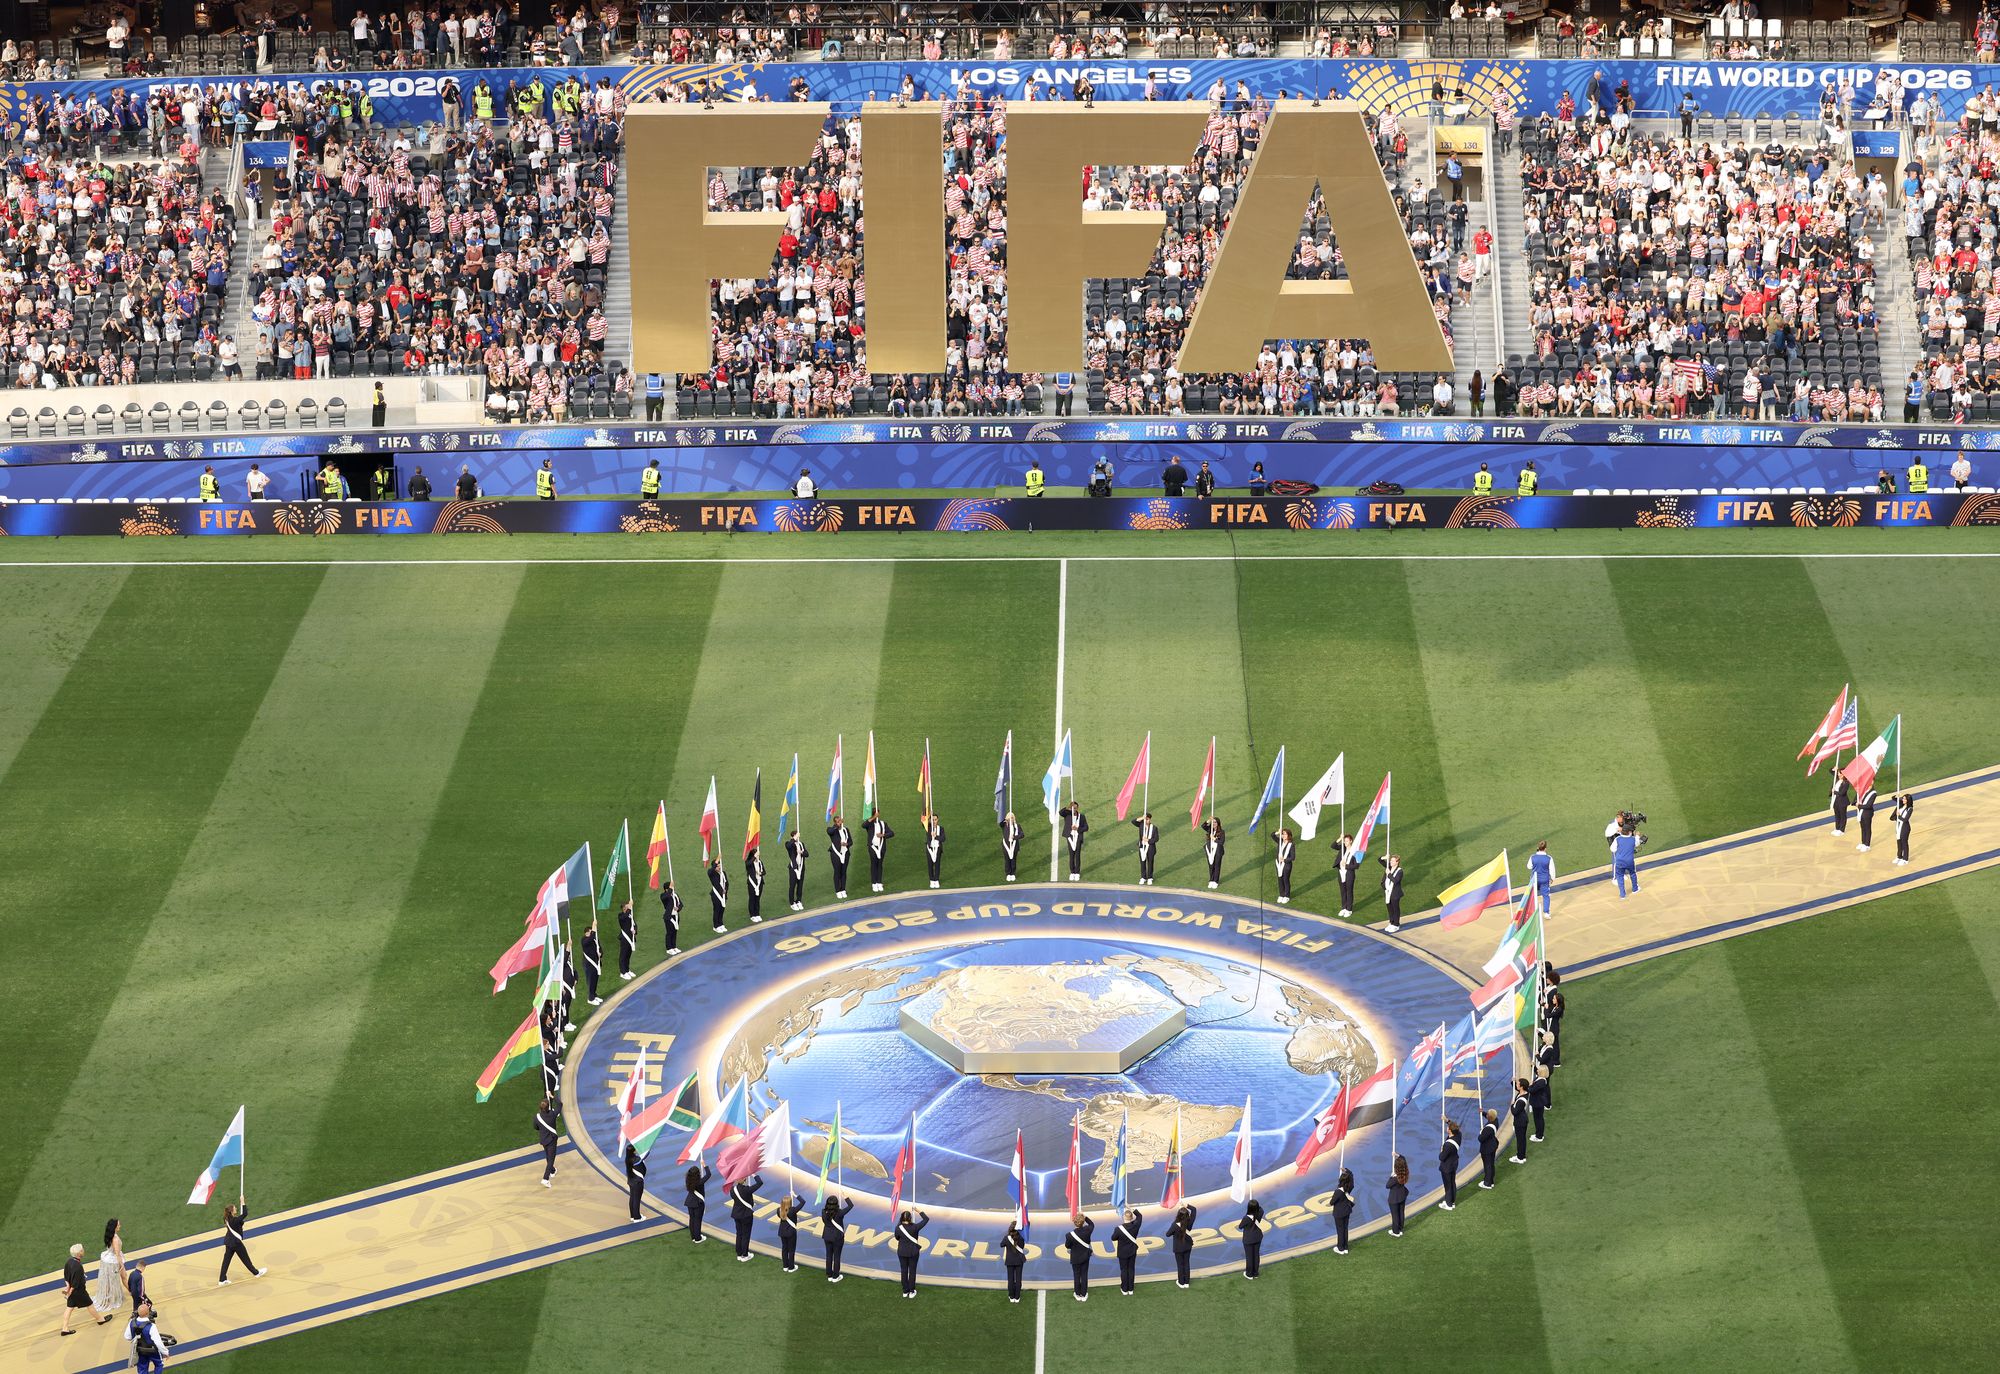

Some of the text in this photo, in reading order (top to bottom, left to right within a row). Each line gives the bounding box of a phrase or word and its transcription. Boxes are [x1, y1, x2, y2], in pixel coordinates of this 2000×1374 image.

[950, 68, 1192, 85] LOS ANGELES
[1656, 66, 1714, 86] FIFA
[1718, 67, 1816, 88] WORLD
[1820, 68, 1874, 88] CUP
[1440, 141, 1477, 150] 131 130
[1855, 146, 1894, 155] 130 129
[249, 156, 288, 165] 134 133
[624, 102, 1455, 374] FIFA
[634, 431, 667, 443] FIFA
[724, 429, 758, 441] FIFA
[889, 427, 922, 438] FIFA
[980, 426, 1013, 438] FIFA
[1145, 425, 1178, 437] FIFA
[1235, 425, 1268, 437] FIFA
[1401, 426, 1434, 438] FIFA
[1492, 427, 1525, 438] FIFA
[1659, 428, 1692, 440] FIFA
[1750, 430, 1784, 442] FIFA
[378, 437, 411, 449] FIFA
[469, 434, 502, 446] FIFA
[1918, 433, 1951, 445] FIFA
[122, 445, 155, 457] FIFA
[212, 441, 246, 453] FIFA
[701, 506, 758, 525] FIFA
[858, 505, 916, 525] FIFA
[1210, 503, 1268, 523] FIFA
[1368, 502, 1426, 522] FIFA
[1716, 501, 1775, 521] FIFA
[1874, 500, 1933, 520] FIFA
[199, 509, 257, 529] FIFA
[355, 508, 412, 528] FIFA
[774, 902, 1334, 954] FIFA WORLD CUP 2026
